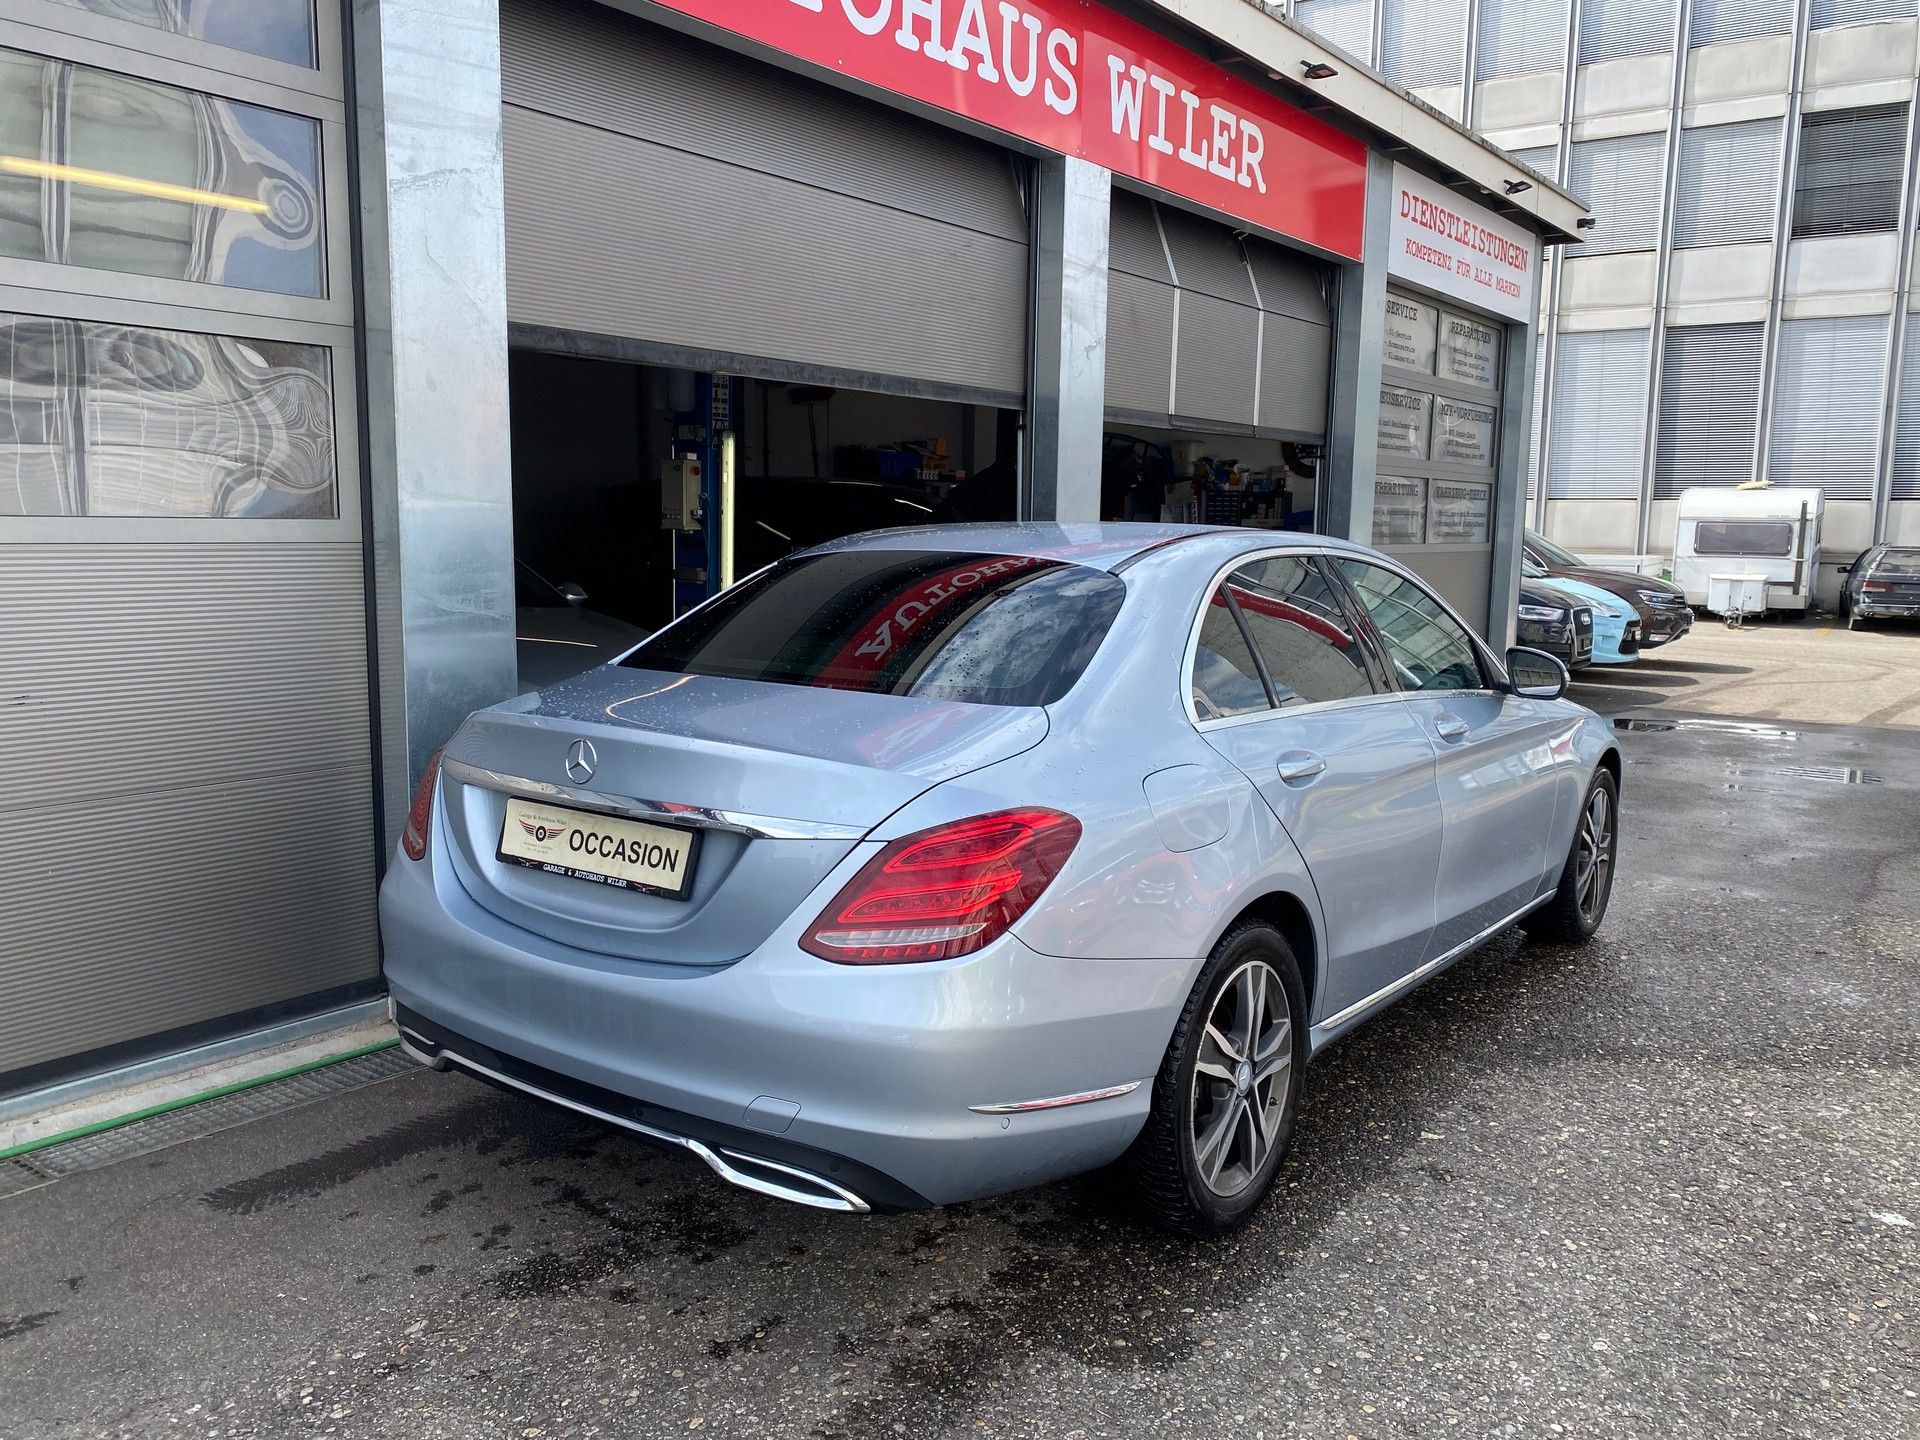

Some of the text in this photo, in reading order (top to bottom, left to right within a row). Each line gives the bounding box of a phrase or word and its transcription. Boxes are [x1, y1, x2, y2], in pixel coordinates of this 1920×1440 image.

[1107, 54, 1267, 194] WILER
[1400, 190, 1529, 273] DIENSTLEISTUNGEN
[1405, 238, 1521, 299] KOMPETENZ FÜR ALLE MARKEN
[1386, 299, 1418, 322] SERVICE
[543, 863, 566, 874] GARAGE
[574, 870, 605, 883] AUTOHAUS
[607, 877, 627, 888] WILER
[569, 829, 680, 873] OCCASION
